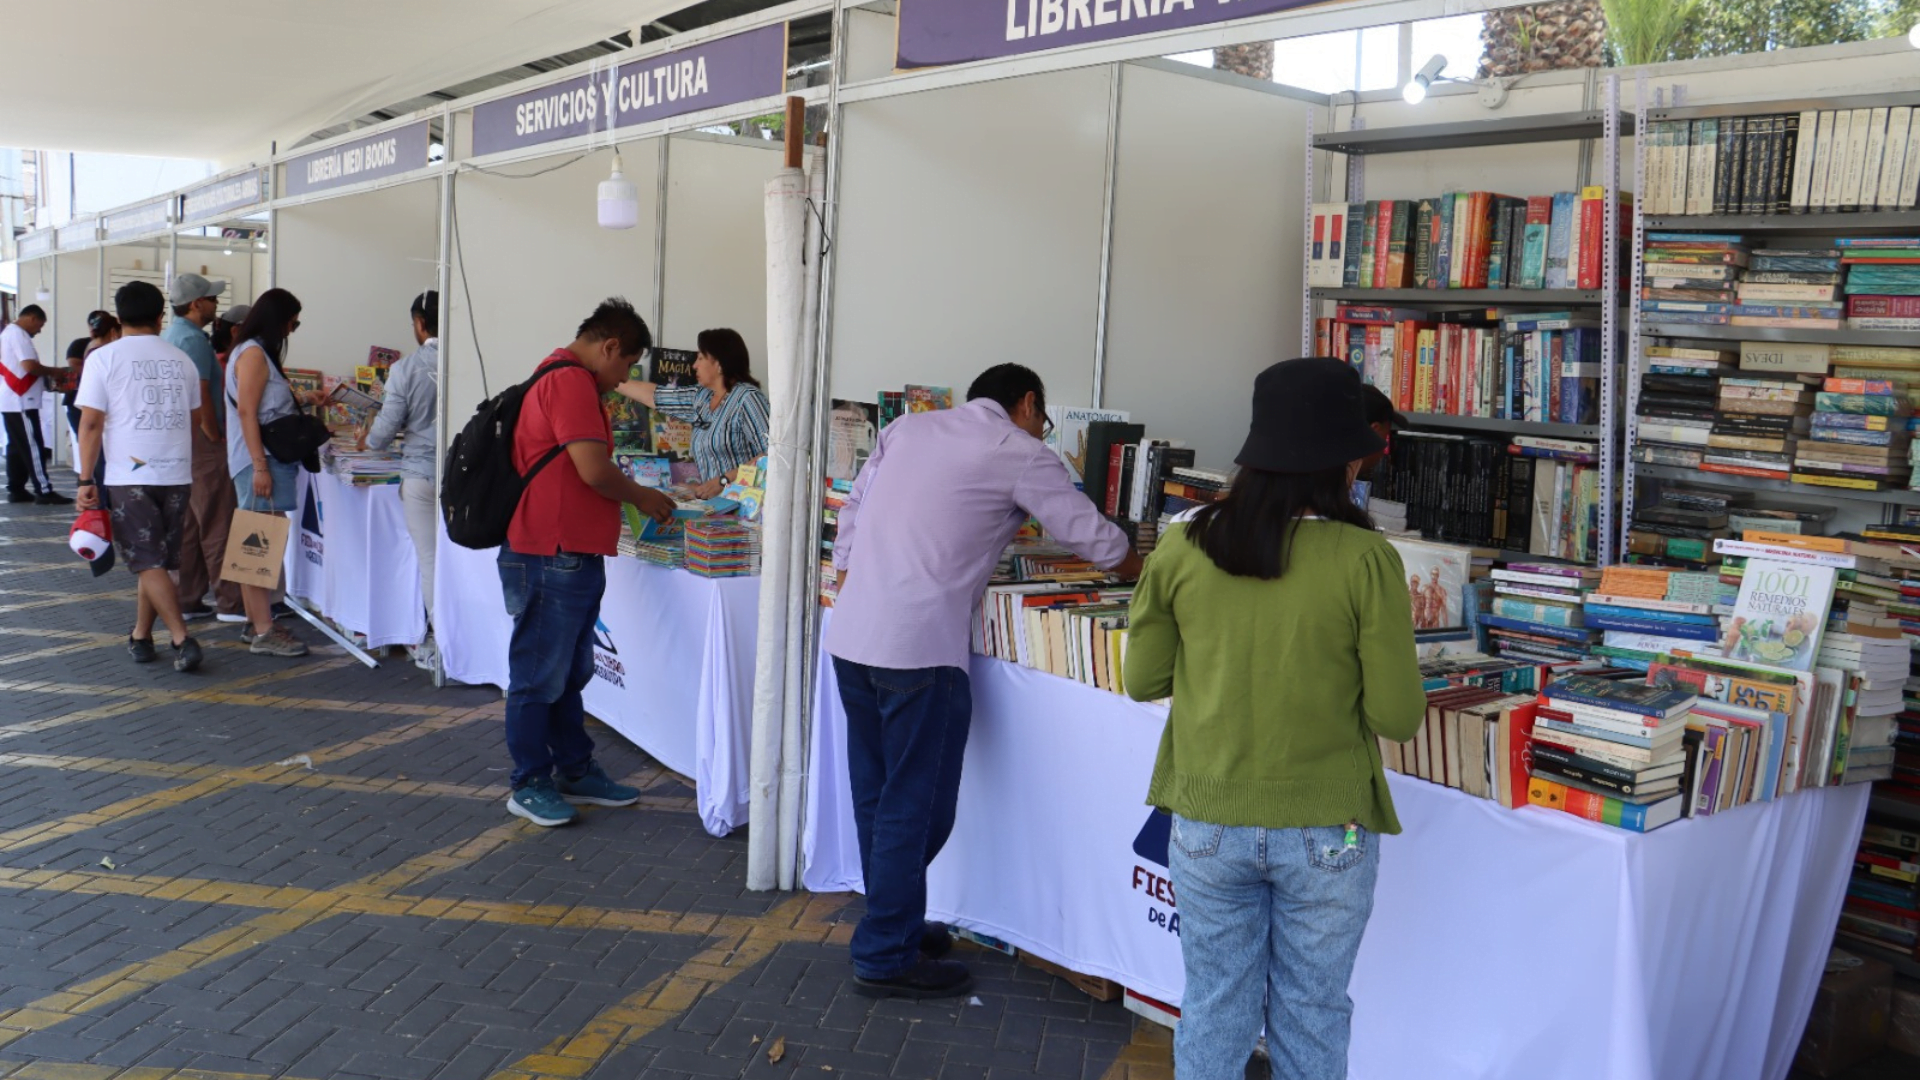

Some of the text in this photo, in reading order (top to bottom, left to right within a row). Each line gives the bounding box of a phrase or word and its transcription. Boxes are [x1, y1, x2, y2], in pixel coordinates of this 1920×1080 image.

[1006, 0, 1195, 41] LIBRE
[515, 56, 708, 136] SERVICIOS Y CULTURA
[307, 138, 396, 184] LIBRERÍA MEDI BOOKS
[658, 359, 692, 377] MAGIA
[1746, 353, 1784, 364] IDEAS
[132, 360, 185, 380] KICK
[142, 384, 183, 405] OFF
[135, 410, 186, 430] 2023
[1755, 571, 1811, 597] 1001
[1748, 602, 1805, 616] NATURALES
[1750, 591, 1807, 607] REMEDIOS
[1148, 907, 1166, 928] De
